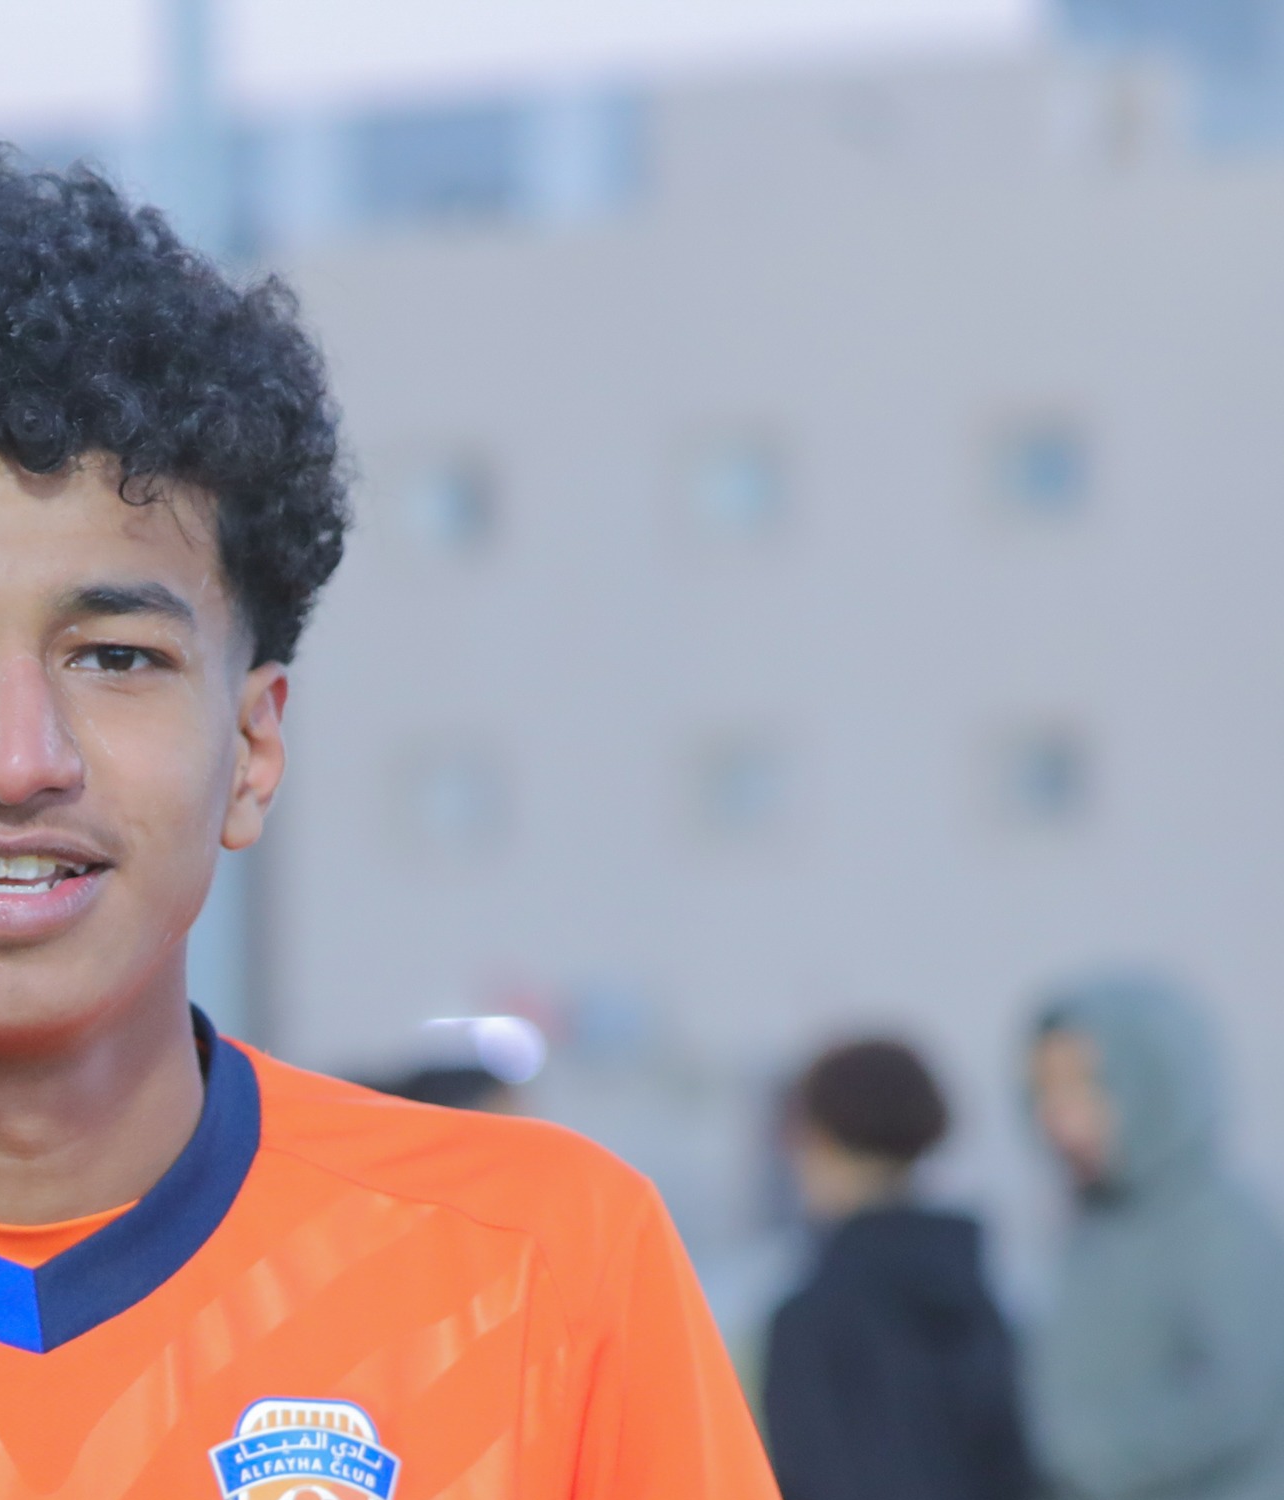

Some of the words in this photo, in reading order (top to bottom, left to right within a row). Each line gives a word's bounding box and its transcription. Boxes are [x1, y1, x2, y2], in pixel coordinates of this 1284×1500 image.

[234, 1431, 329, 1464] الفيحاء
[330, 1442, 383, 1470] نادي
[240, 1457, 323, 1484] ALFAYHA
[330, 1461, 377, 1489] CLUB
